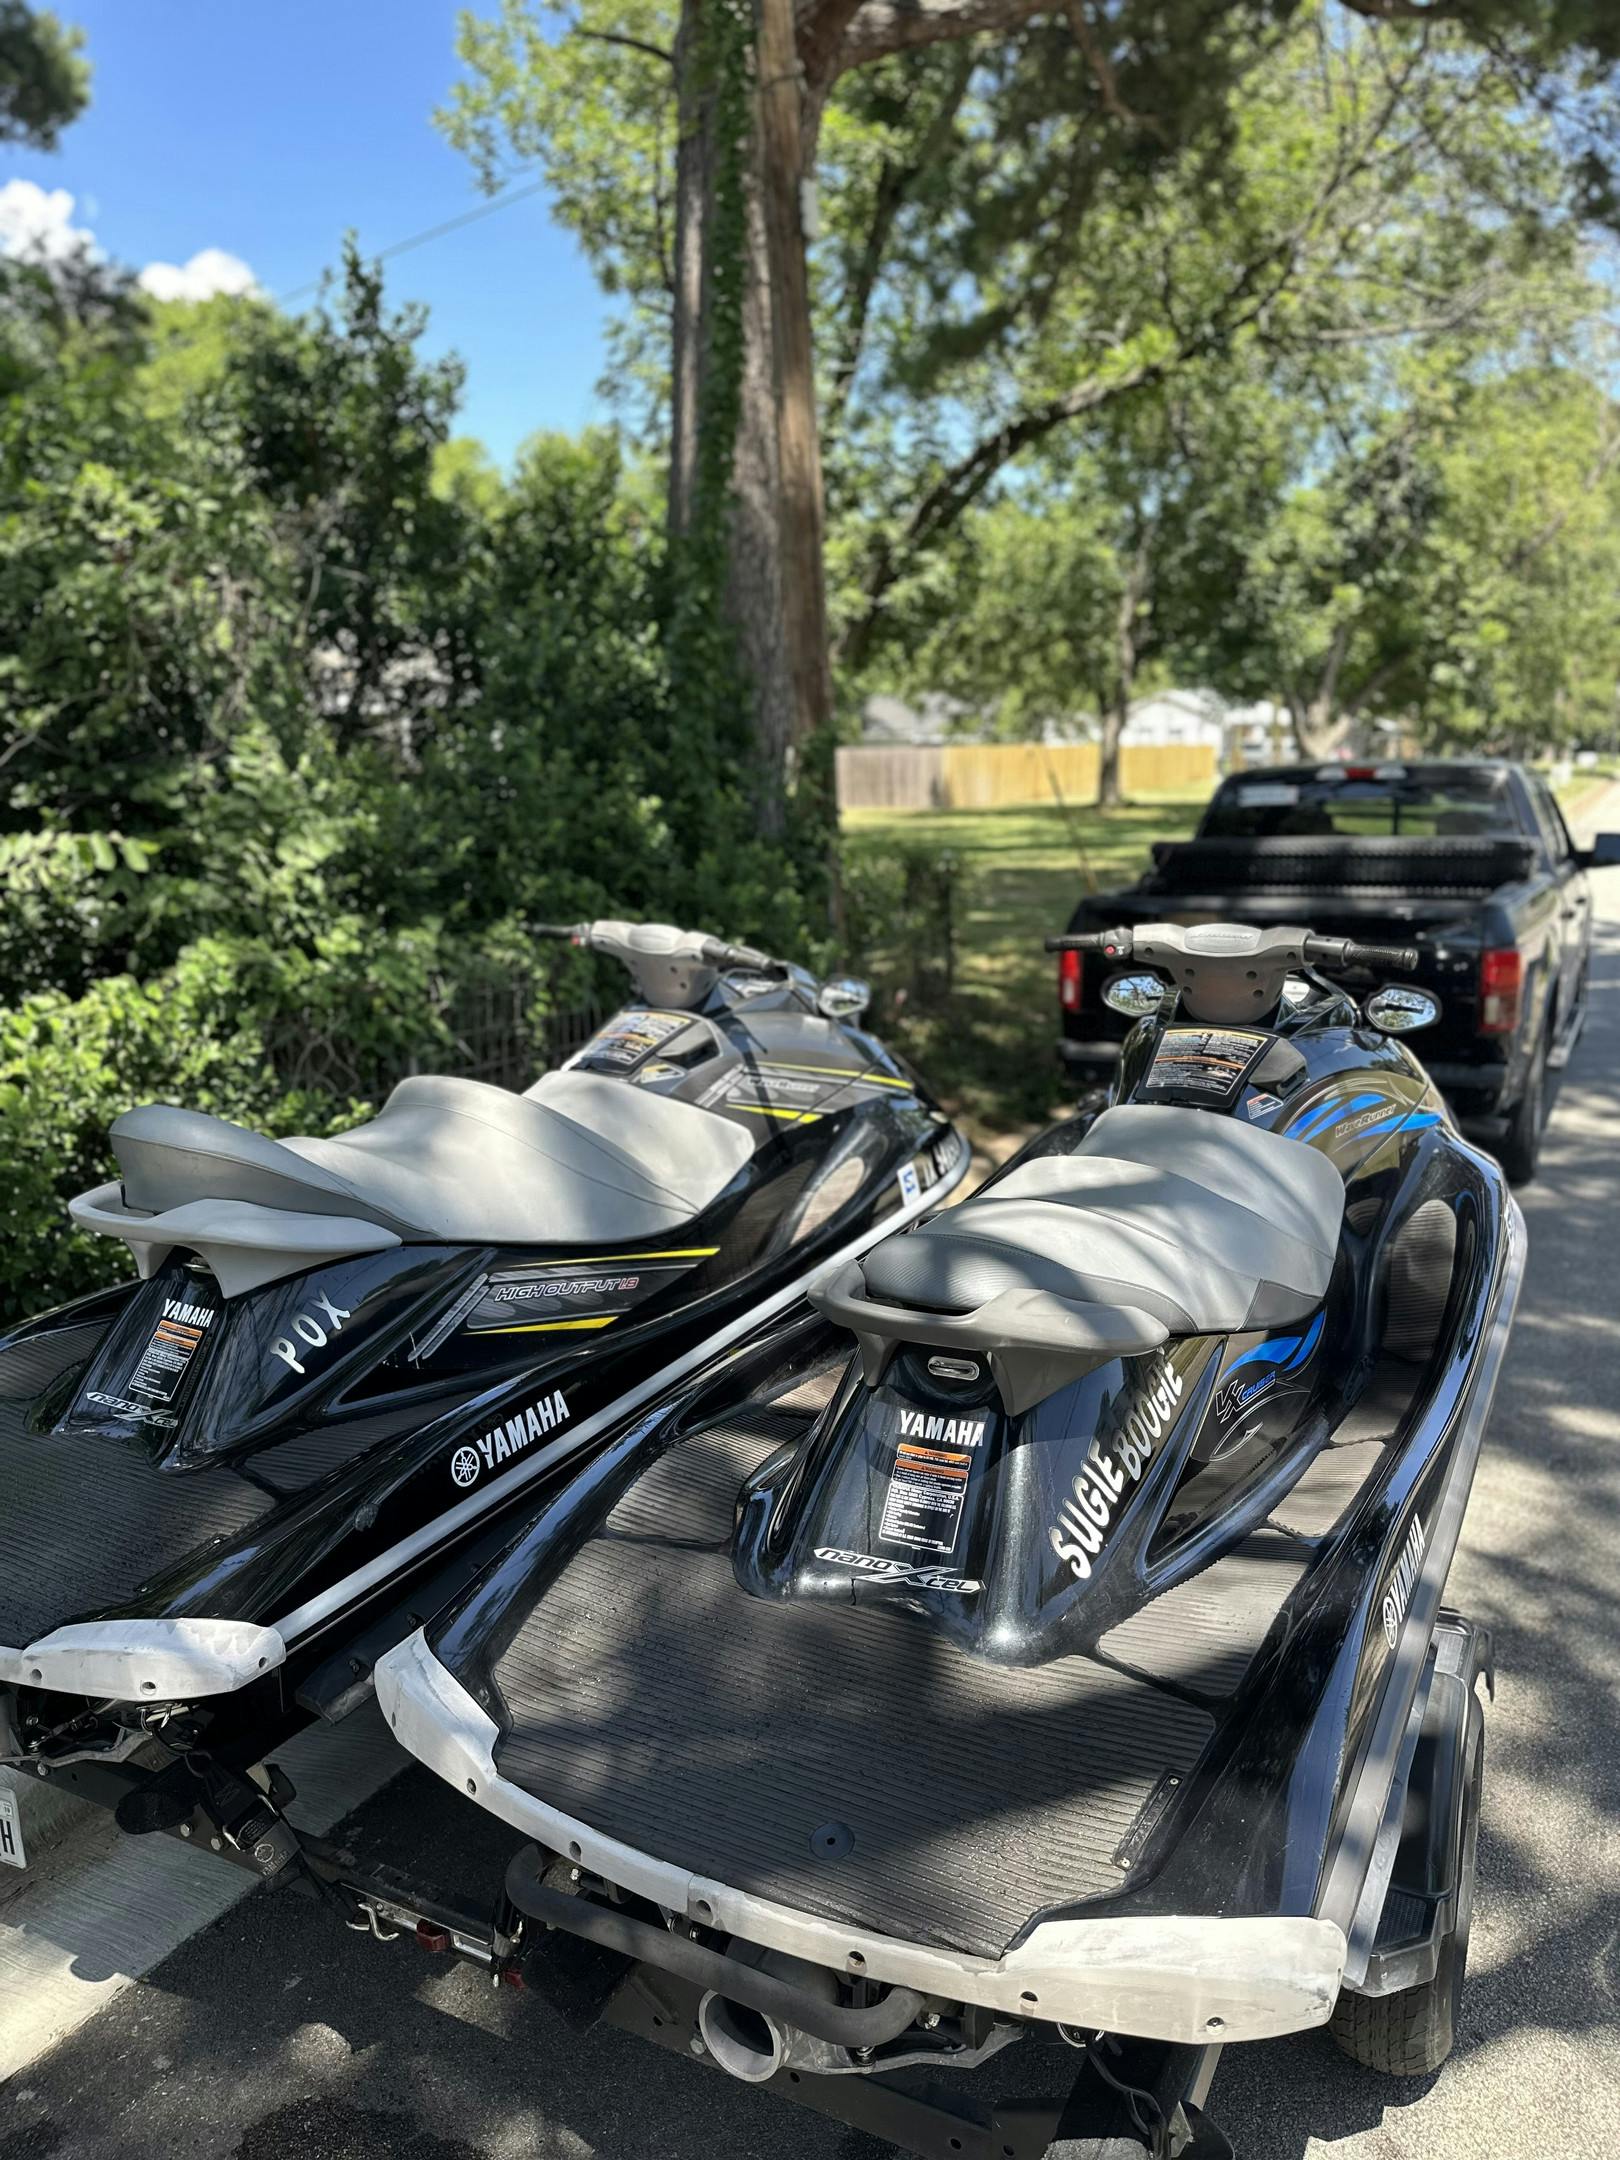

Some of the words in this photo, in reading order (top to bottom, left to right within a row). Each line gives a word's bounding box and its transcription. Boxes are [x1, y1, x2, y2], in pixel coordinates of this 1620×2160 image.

[162, 1298, 215, 1328] YAMAHA
[495, 1284, 544, 1302] HIGH
[543, 1278, 621, 1296] OUTPUT
[270, 1289, 350, 1374] POX
[476, 1389, 571, 1470] YAMAHA
[900, 1409, 986, 1447] YAMAHA
[1049, 1437, 1124, 1579] SUGIE
[1390, 1512, 1426, 1624] YAMAHA
